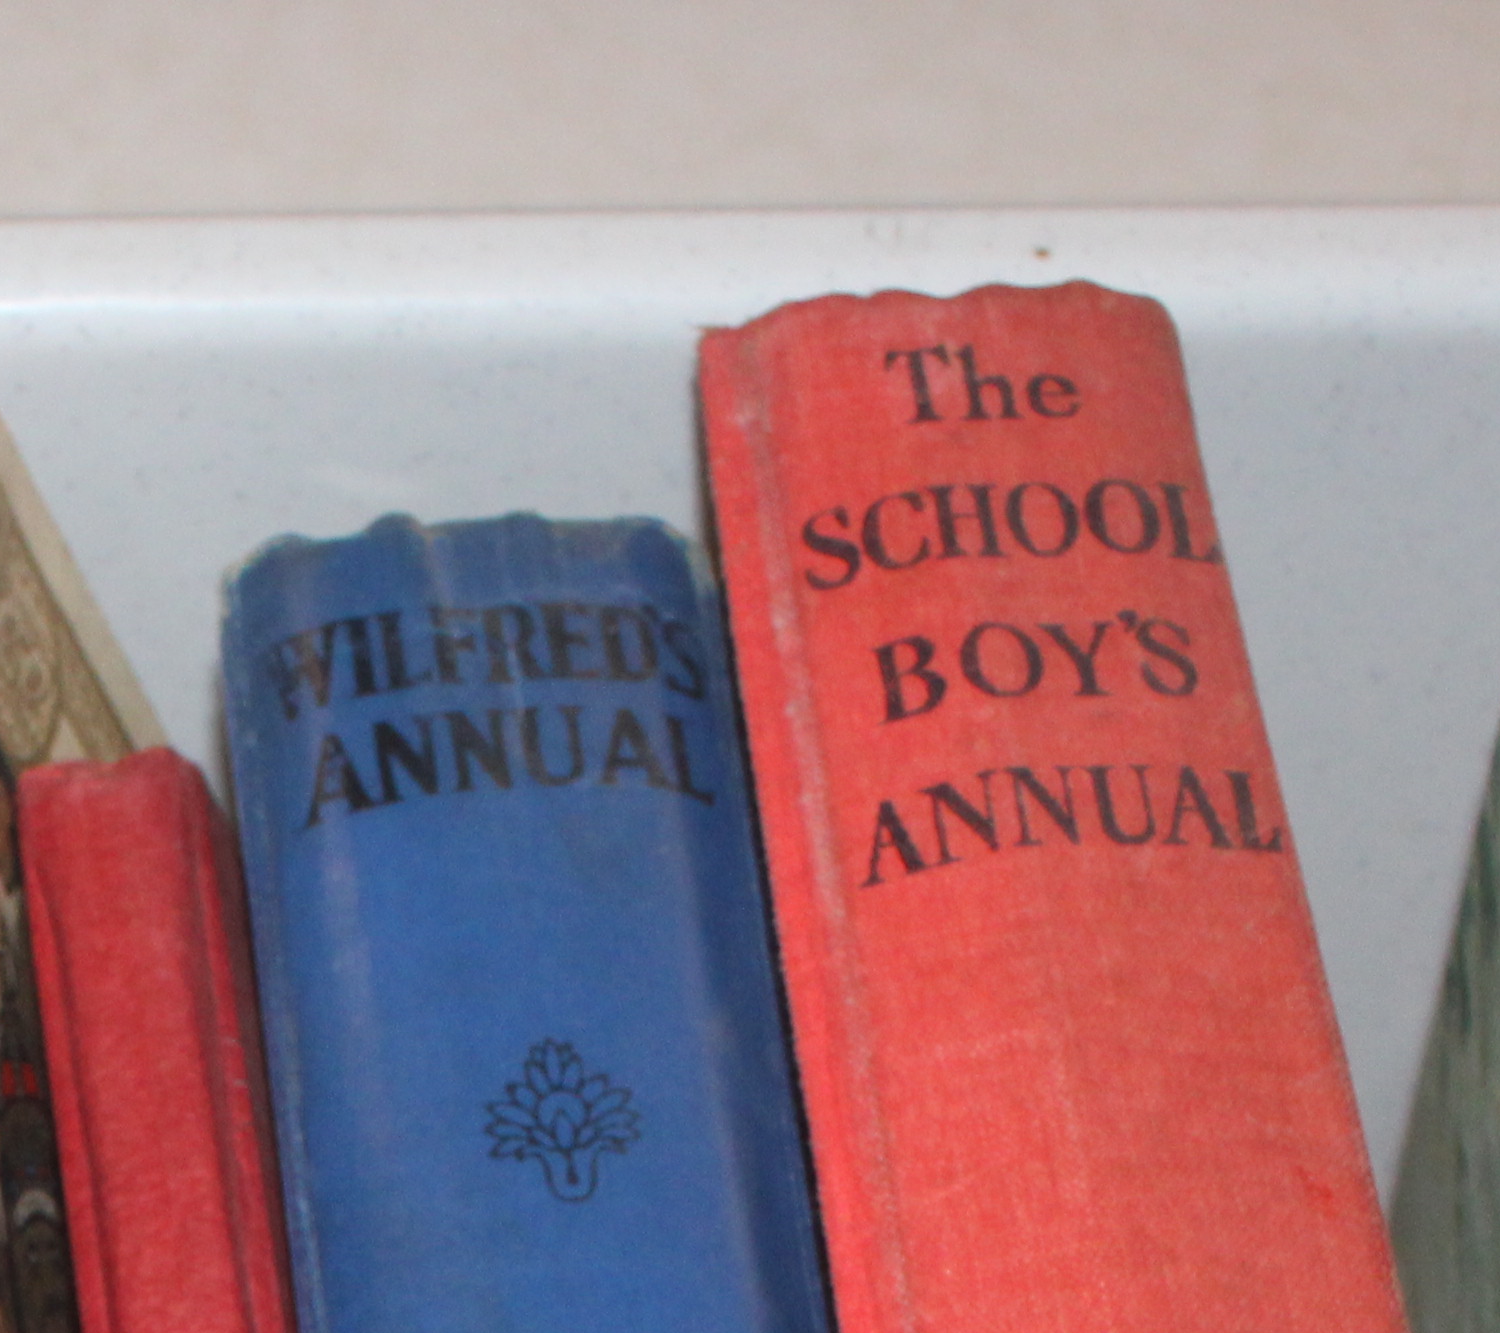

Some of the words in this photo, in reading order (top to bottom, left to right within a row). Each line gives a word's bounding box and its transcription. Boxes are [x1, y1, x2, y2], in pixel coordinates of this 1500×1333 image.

[885, 343, 1081, 424] The
[801, 478, 1228, 592] SCHOOL
[872, 608, 1199, 725] BOY'S
[304, 705, 715, 830] ANNUAL
[858, 764, 1284, 889] ANNUAL
